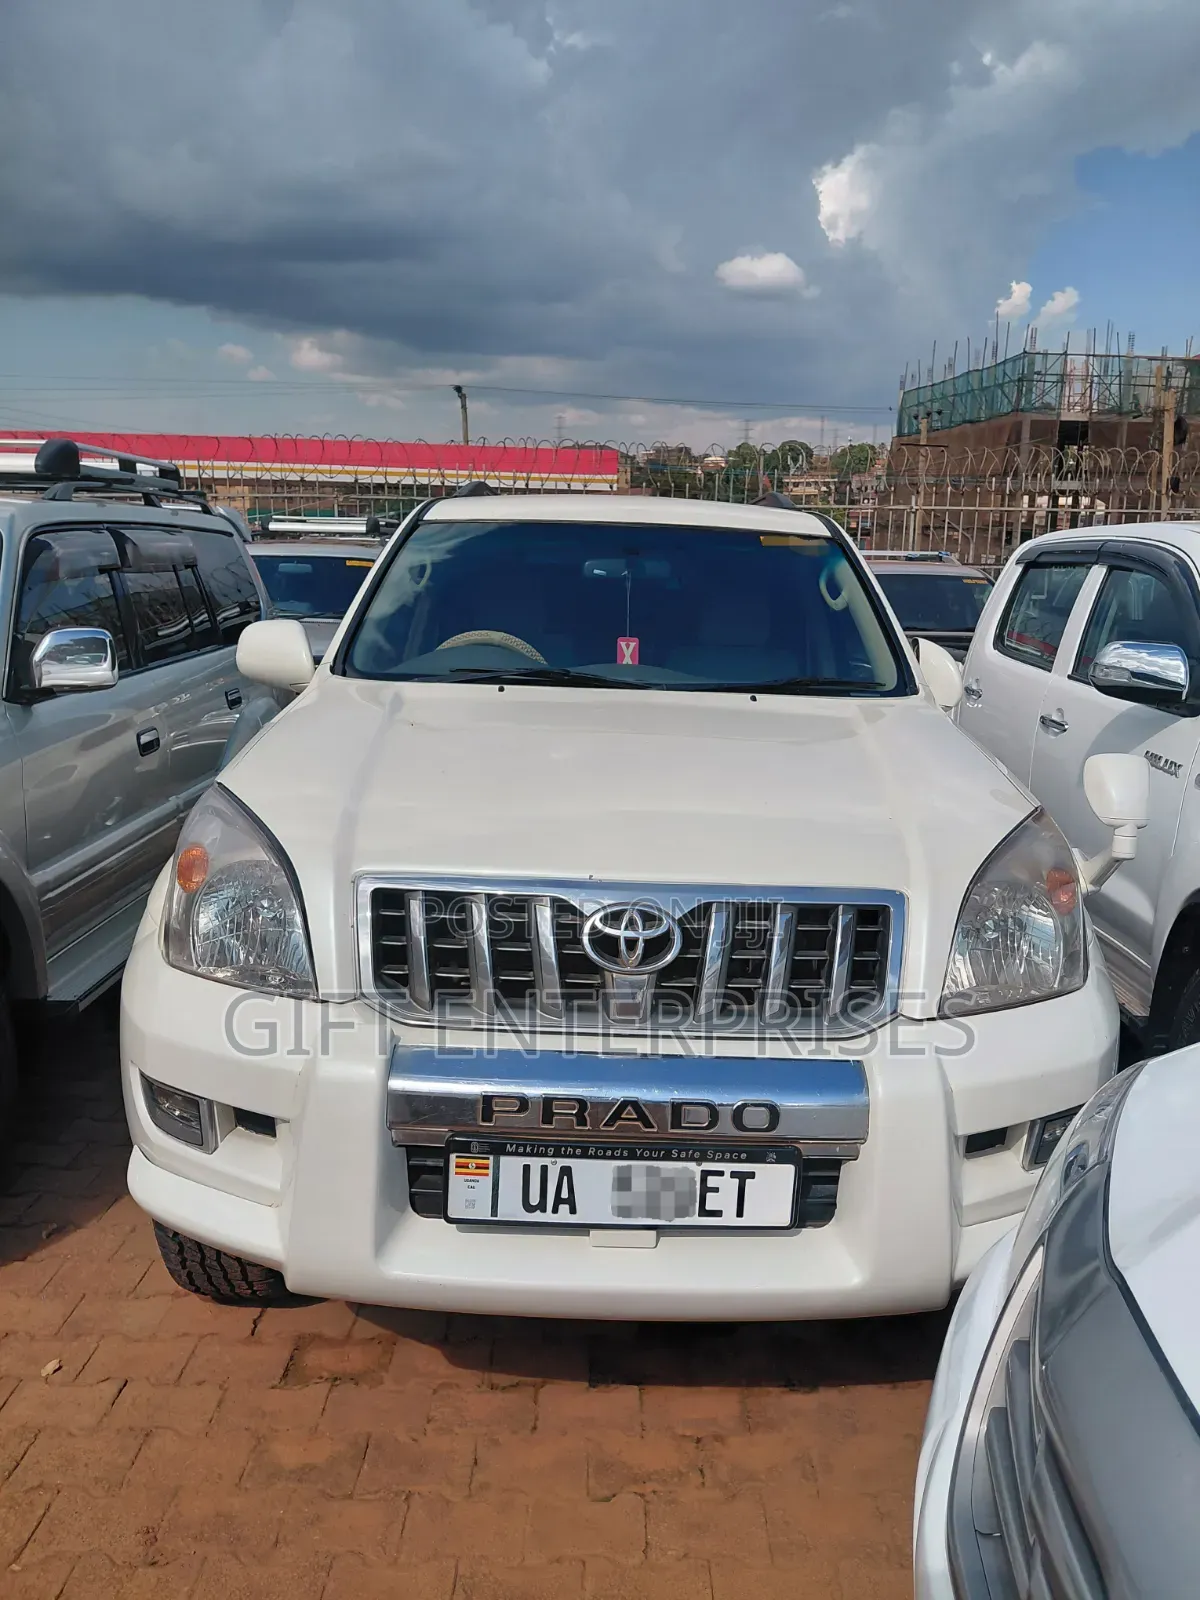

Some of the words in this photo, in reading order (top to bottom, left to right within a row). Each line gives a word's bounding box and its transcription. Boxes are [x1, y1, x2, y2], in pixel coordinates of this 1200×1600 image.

[479, 1092, 781, 1133] PRADO
[505, 1143, 555, 1156] Making
[560, 1147, 582, 1156] the
[588, 1147, 629, 1158] Roads
[635, 1148, 665, 1159] Your
[671, 1149, 701, 1160] Safe
[706, 1150, 748, 1162] Space
[521, 1163, 578, 1216] UA
[697, 1168, 757, 1219] ET
